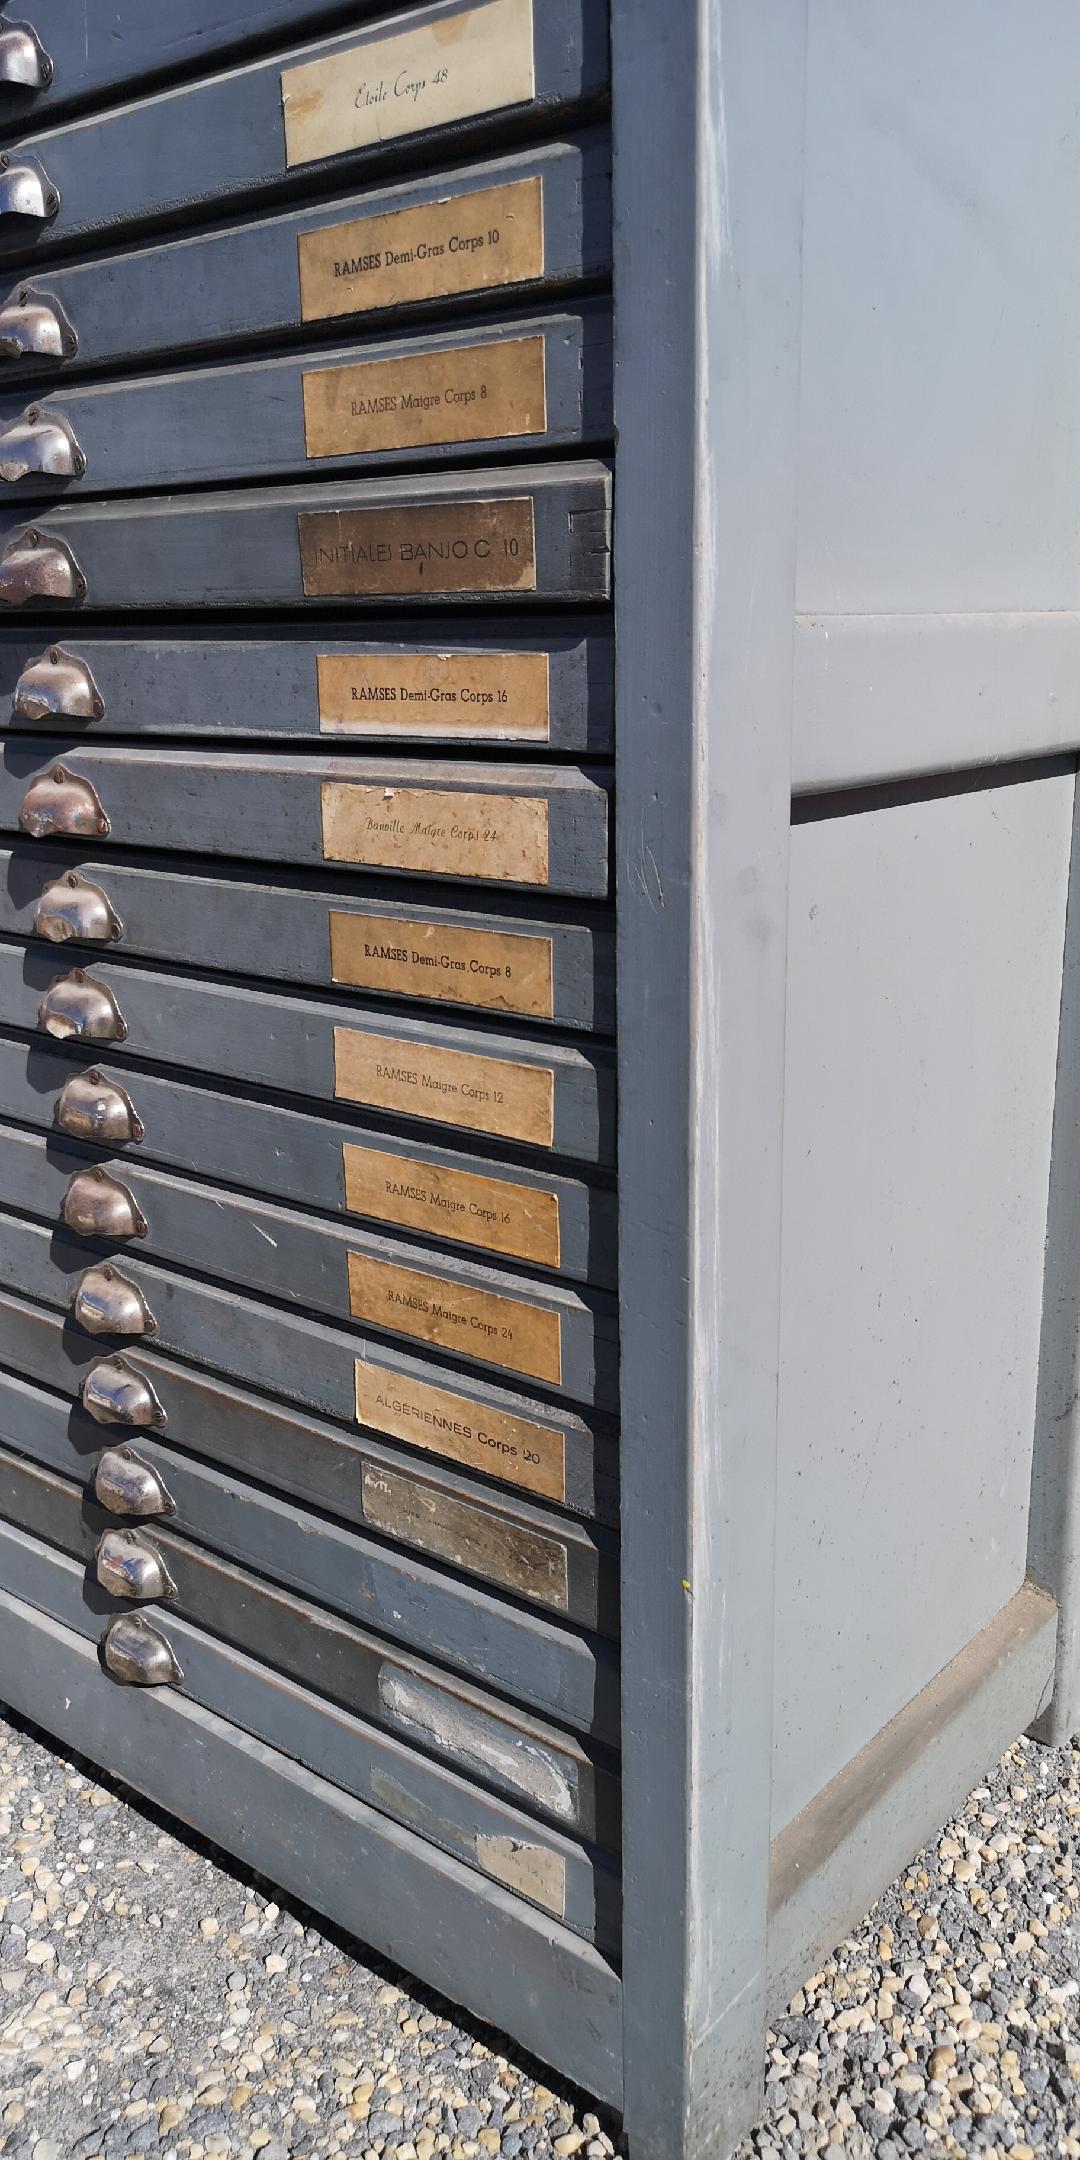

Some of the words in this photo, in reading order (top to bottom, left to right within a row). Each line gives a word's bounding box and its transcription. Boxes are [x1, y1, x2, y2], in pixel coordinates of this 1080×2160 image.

[394, 70, 426, 102] Corps
[432, 68, 448, 85] 48
[334, 253, 381, 277] RAMSES
[385, 243, 445, 267] Demi-Gras
[449, 234, 484, 253] Corps
[487, 229, 500, 244] 10
[351, 396, 397, 416] RAMSES
[401, 392, 441, 410] Maigre
[444, 388, 476, 405] Corps
[480, 385, 487, 399] 8
[315, 543, 392, 564] INITIALES
[400, 540, 468, 561] BANJO
[503, 538, 518, 557] 10
[351, 687, 397, 701] RAMSES
[400, 688, 457, 703] Demi-Gras
[460, 688, 494, 705] Corps
[497, 689, 508, 703] 16
[450, 824, 479, 841] Corps
[483, 829, 497, 842] 24
[364, 944, 408, 962] RAMSES
[411, 951, 466, 971] Demi-Gras
[470, 960, 501, 978] Corps
[505, 966, 512, 978] 8
[376, 1064, 418, 1084] RAMSES
[422, 1075, 457, 1094] Maigre
[461, 1083, 489, 1103] Corps
[493, 1090, 504, 1104] 12
[385, 1181, 427, 1201] RAMSES
[430, 1193, 465, 1213] Maigre
[469, 1203, 497, 1223] Corps
[501, 1211, 511, 1224] 16
[387, 1289, 429, 1313] RAMSES
[432, 1303, 467, 1326] Maigre
[470, 1316, 498, 1336] Corps
[501, 1327, 513, 1340] 24
[375, 1394, 472, 1438] ALGÉRIENNES
[477, 1431, 518, 1456] Corps
[522, 1449, 541, 1465] 20
